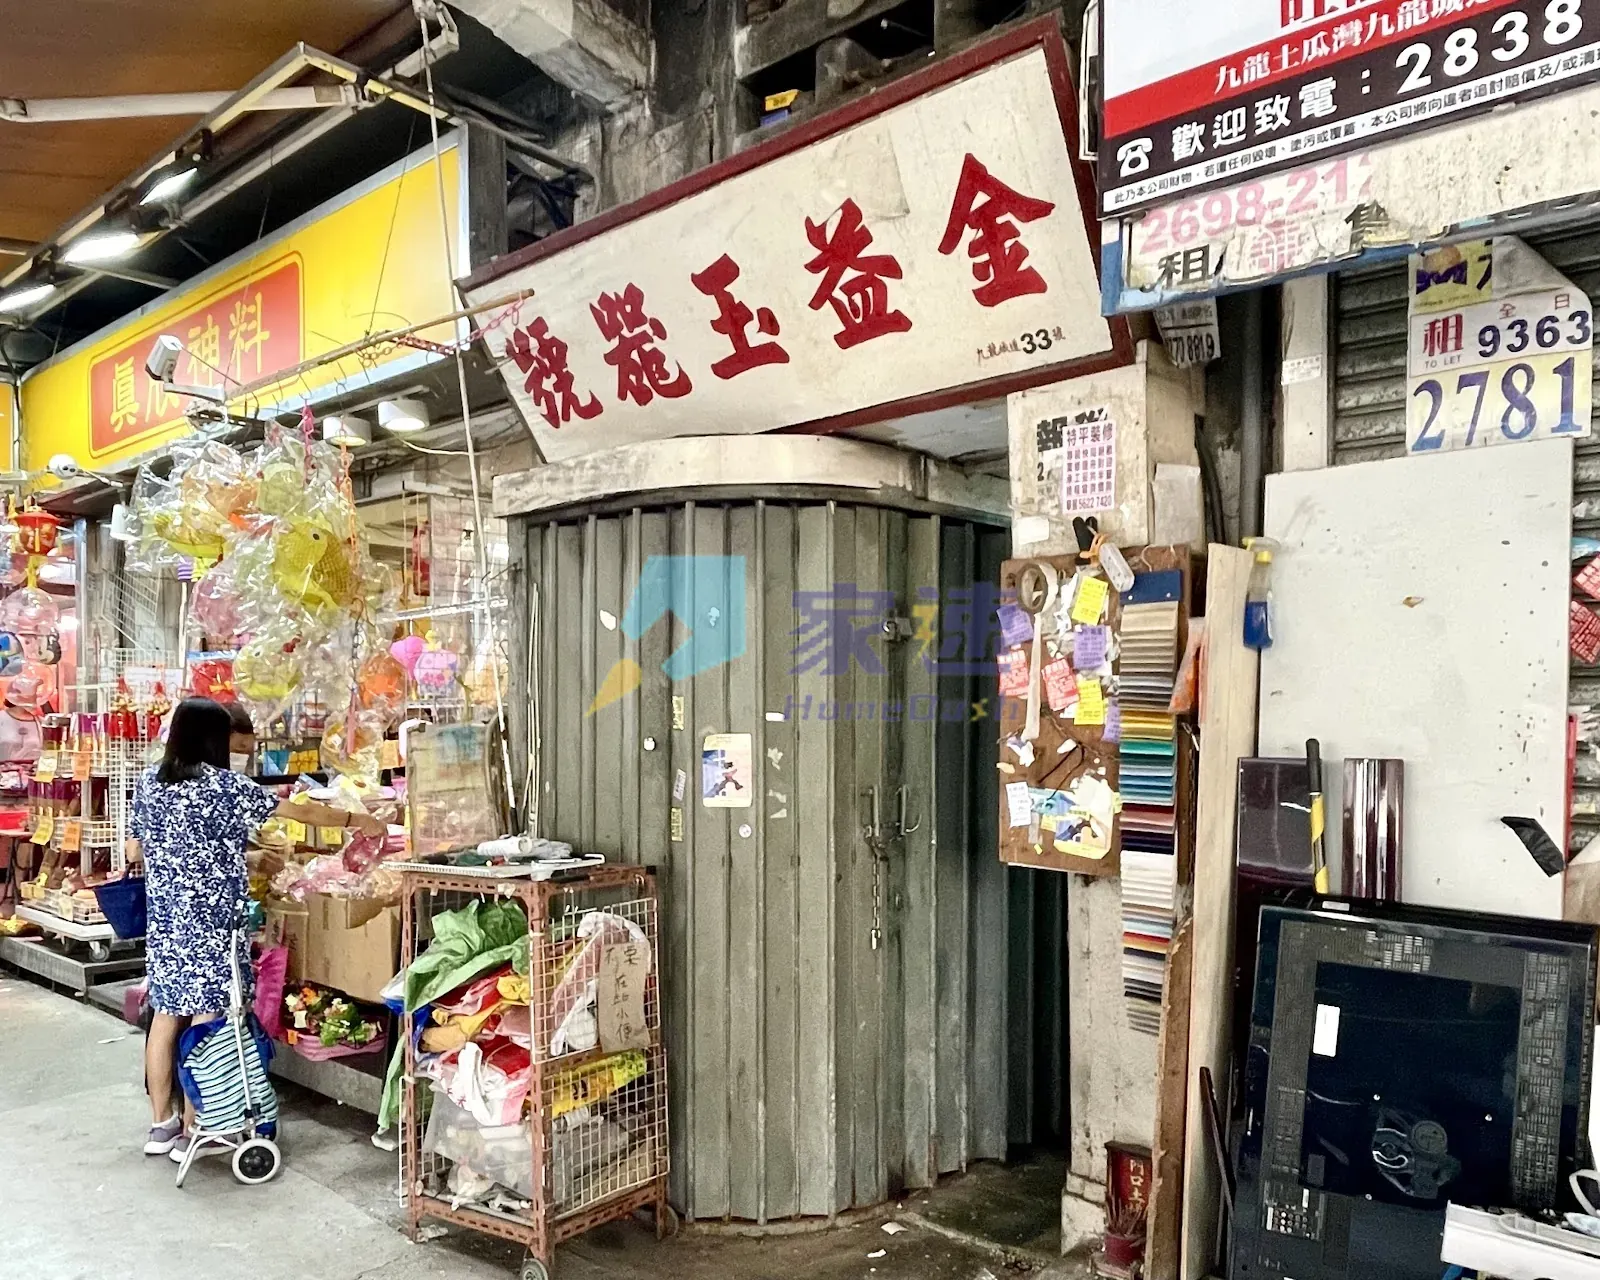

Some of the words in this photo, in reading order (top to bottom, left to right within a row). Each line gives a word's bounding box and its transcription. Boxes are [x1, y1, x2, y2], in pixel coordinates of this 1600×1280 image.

[1395, 0, 1583, 95] 2838
[1157, 244, 1213, 291] 租
[1422, 313, 1465, 357] 租
[1478, 310, 1591, 358] 9363
[1424, 360, 1438, 369] TO
[1443, 356, 1461, 366] LET
[1412, 355, 1583, 453] 2781
[1066, 422, 1113, 447] 特平裝修
